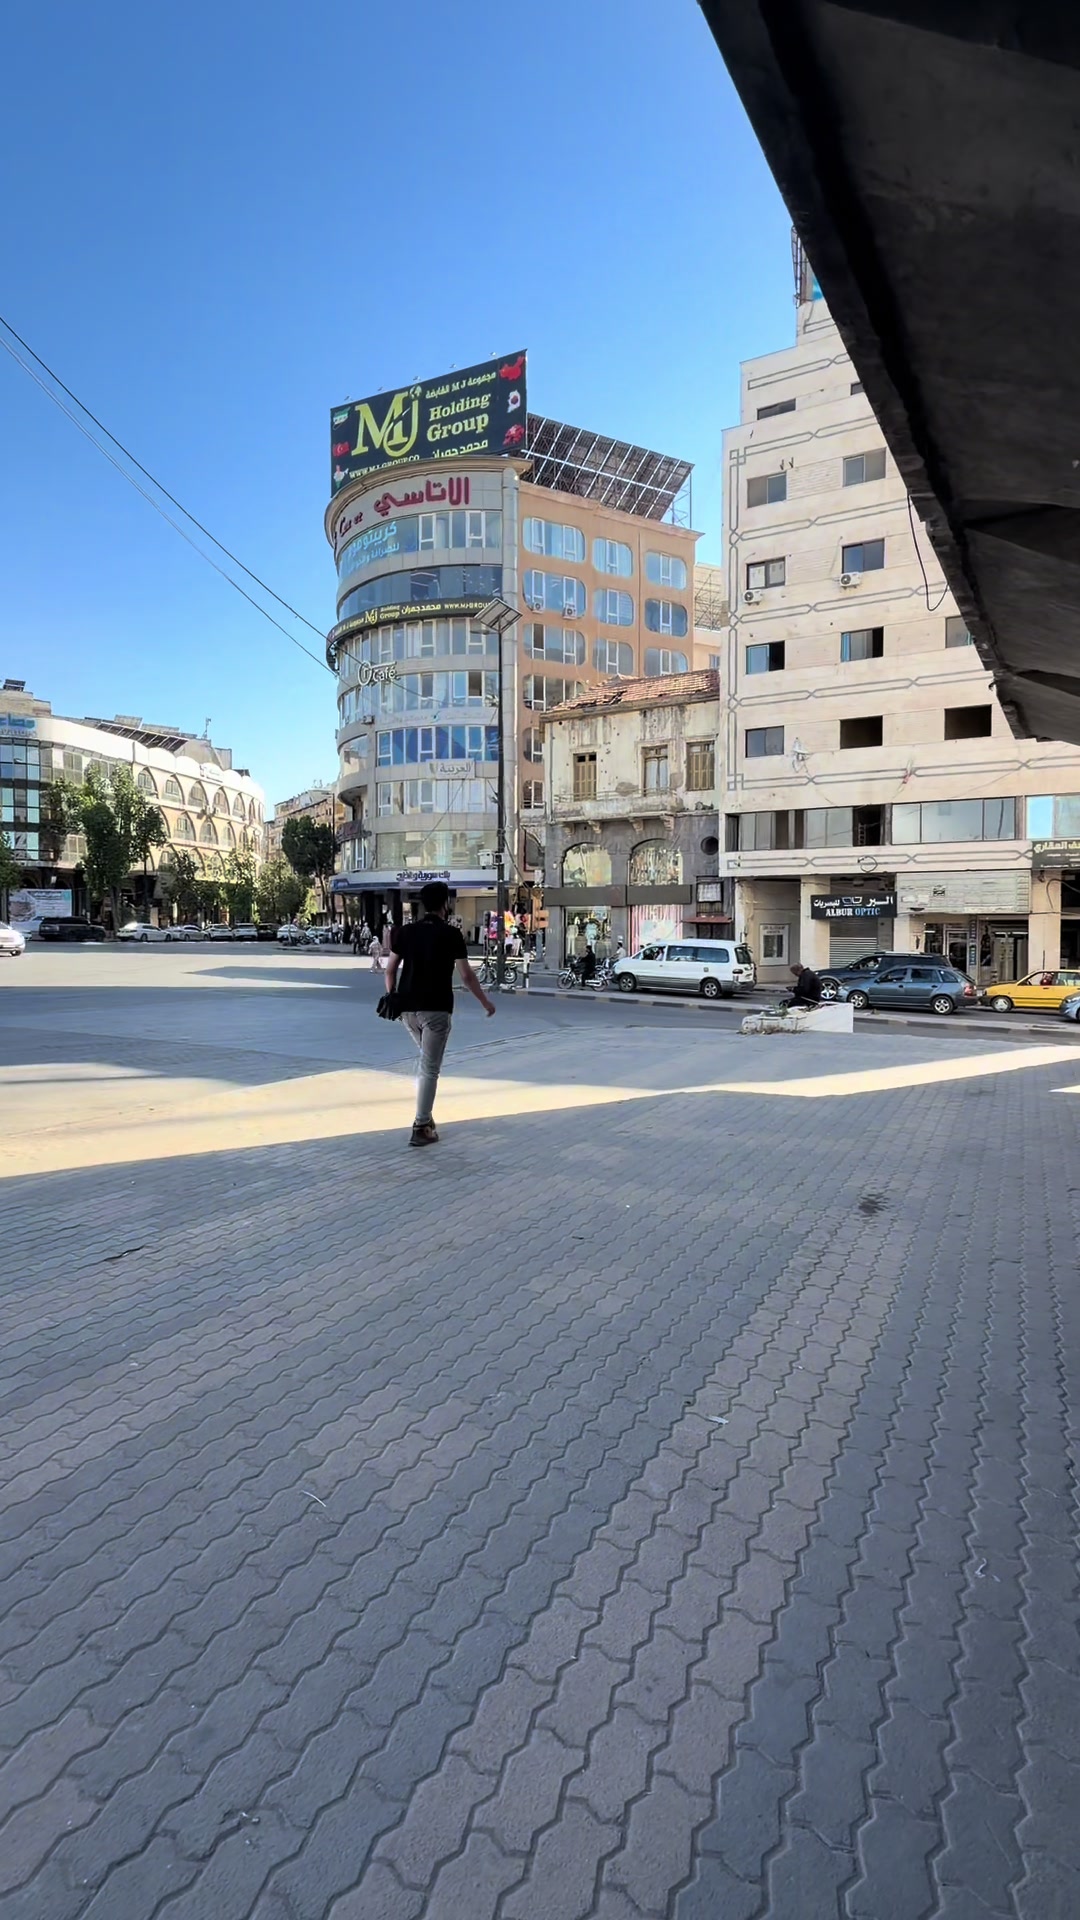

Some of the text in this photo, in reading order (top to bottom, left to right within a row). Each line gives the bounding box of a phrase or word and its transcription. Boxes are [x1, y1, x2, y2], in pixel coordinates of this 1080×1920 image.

[429, 393, 491, 422] Holding
[426, 412, 489, 442] Group
[459, 439, 489, 454] محمد
[825, 907, 881, 917] ALBUR OPTIC
